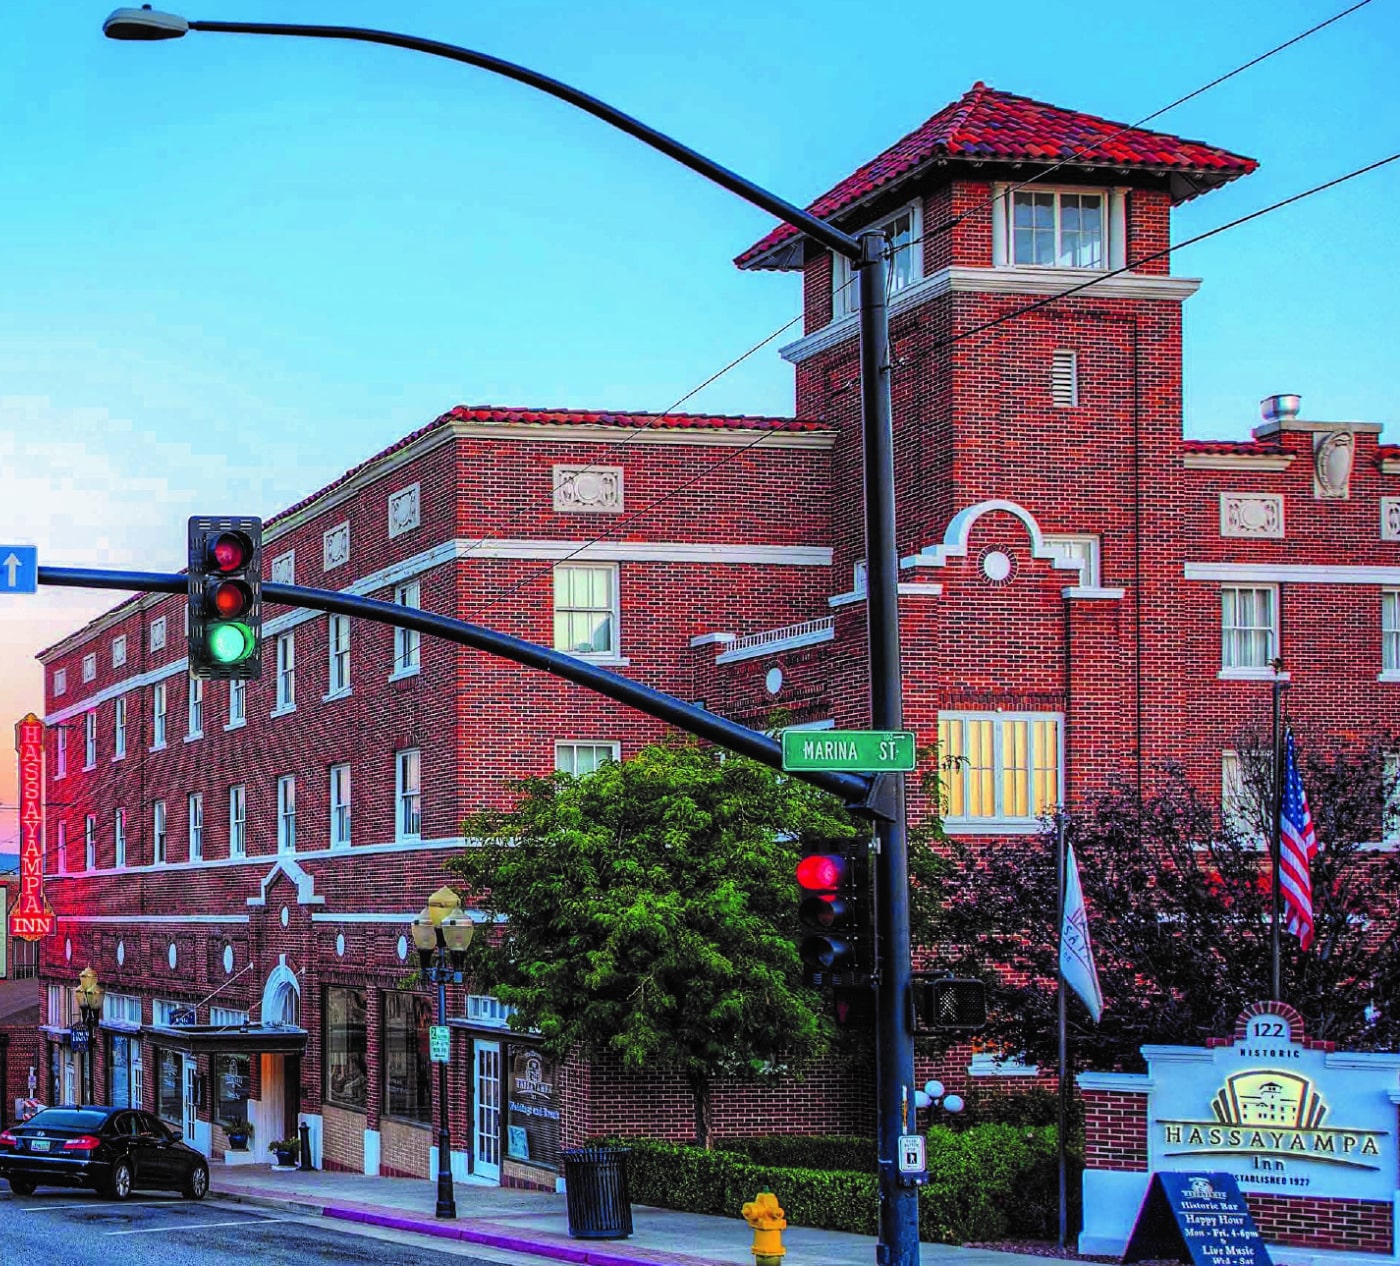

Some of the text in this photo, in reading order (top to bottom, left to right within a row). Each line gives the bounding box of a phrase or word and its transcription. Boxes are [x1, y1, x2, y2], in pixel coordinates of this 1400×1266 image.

[803, 741, 858, 761] MARINA
[22, 725, 41, 914] HASSAYAMPA
[13, 917, 50, 933] INN
[1253, 1023, 1286, 1038] 122
[1240, 1049, 1300, 1059] HISTORIC
[1165, 1126, 1380, 1155] HASSAYAMPA
[1254, 1156, 1286, 1171] Inn
[1233, 1174, 1310, 1187] STABLISHED 1927
[1180, 1201, 1239, 1210] Historic Bar
[1185, 1214, 1244, 1227] Happy Hour
[1184, 1228, 1205, 1237] Mon
[1230, 1228, 1259, 1240] 4-6pm
[1202, 1245, 1255, 1255] Live Music
[1239, 1257, 1254, 1265] Sat
